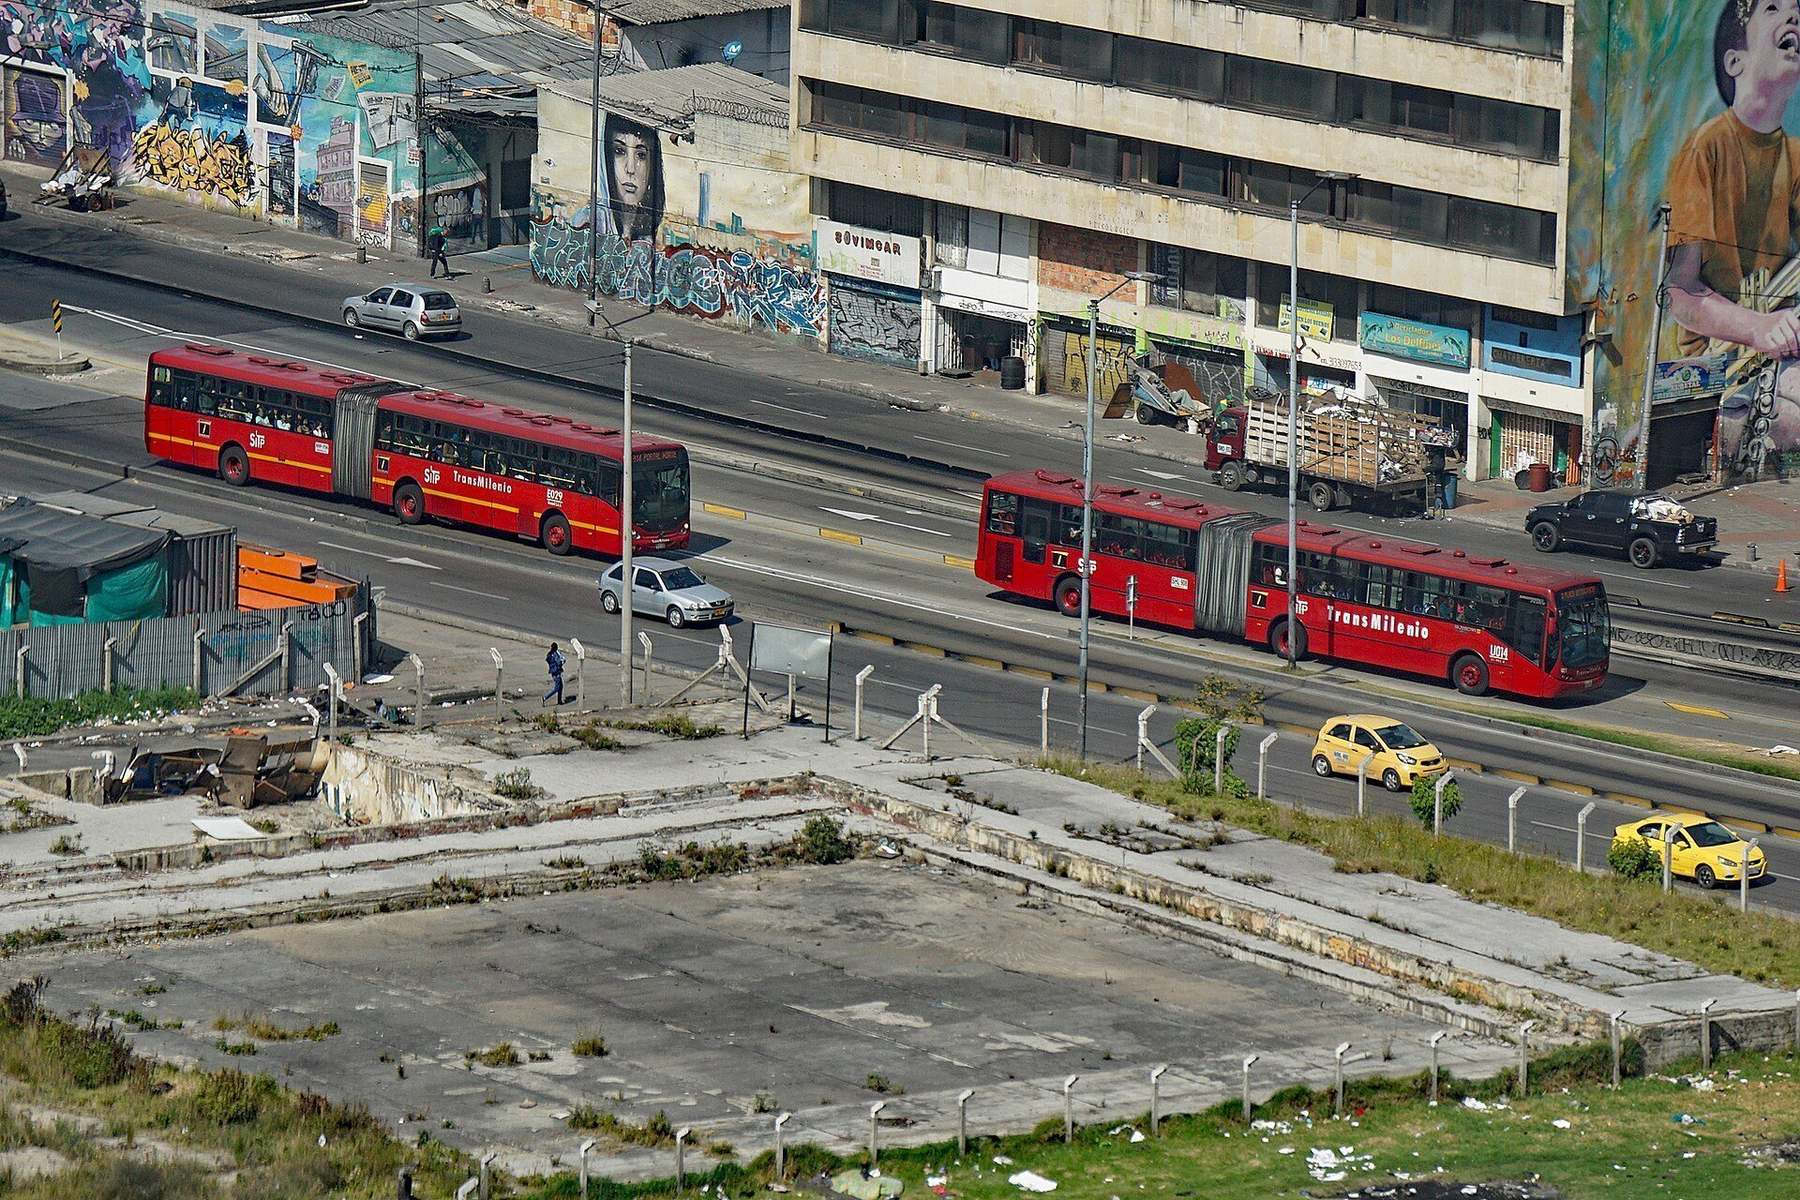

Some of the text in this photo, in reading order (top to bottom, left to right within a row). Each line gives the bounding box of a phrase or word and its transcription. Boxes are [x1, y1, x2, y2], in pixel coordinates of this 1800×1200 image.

[453, 471, 512, 494] TransMilenio
[547, 489, 563, 500] E029
[1326, 605, 1429, 640] TransMilenio
[1490, 644, 1508, 659] U014
